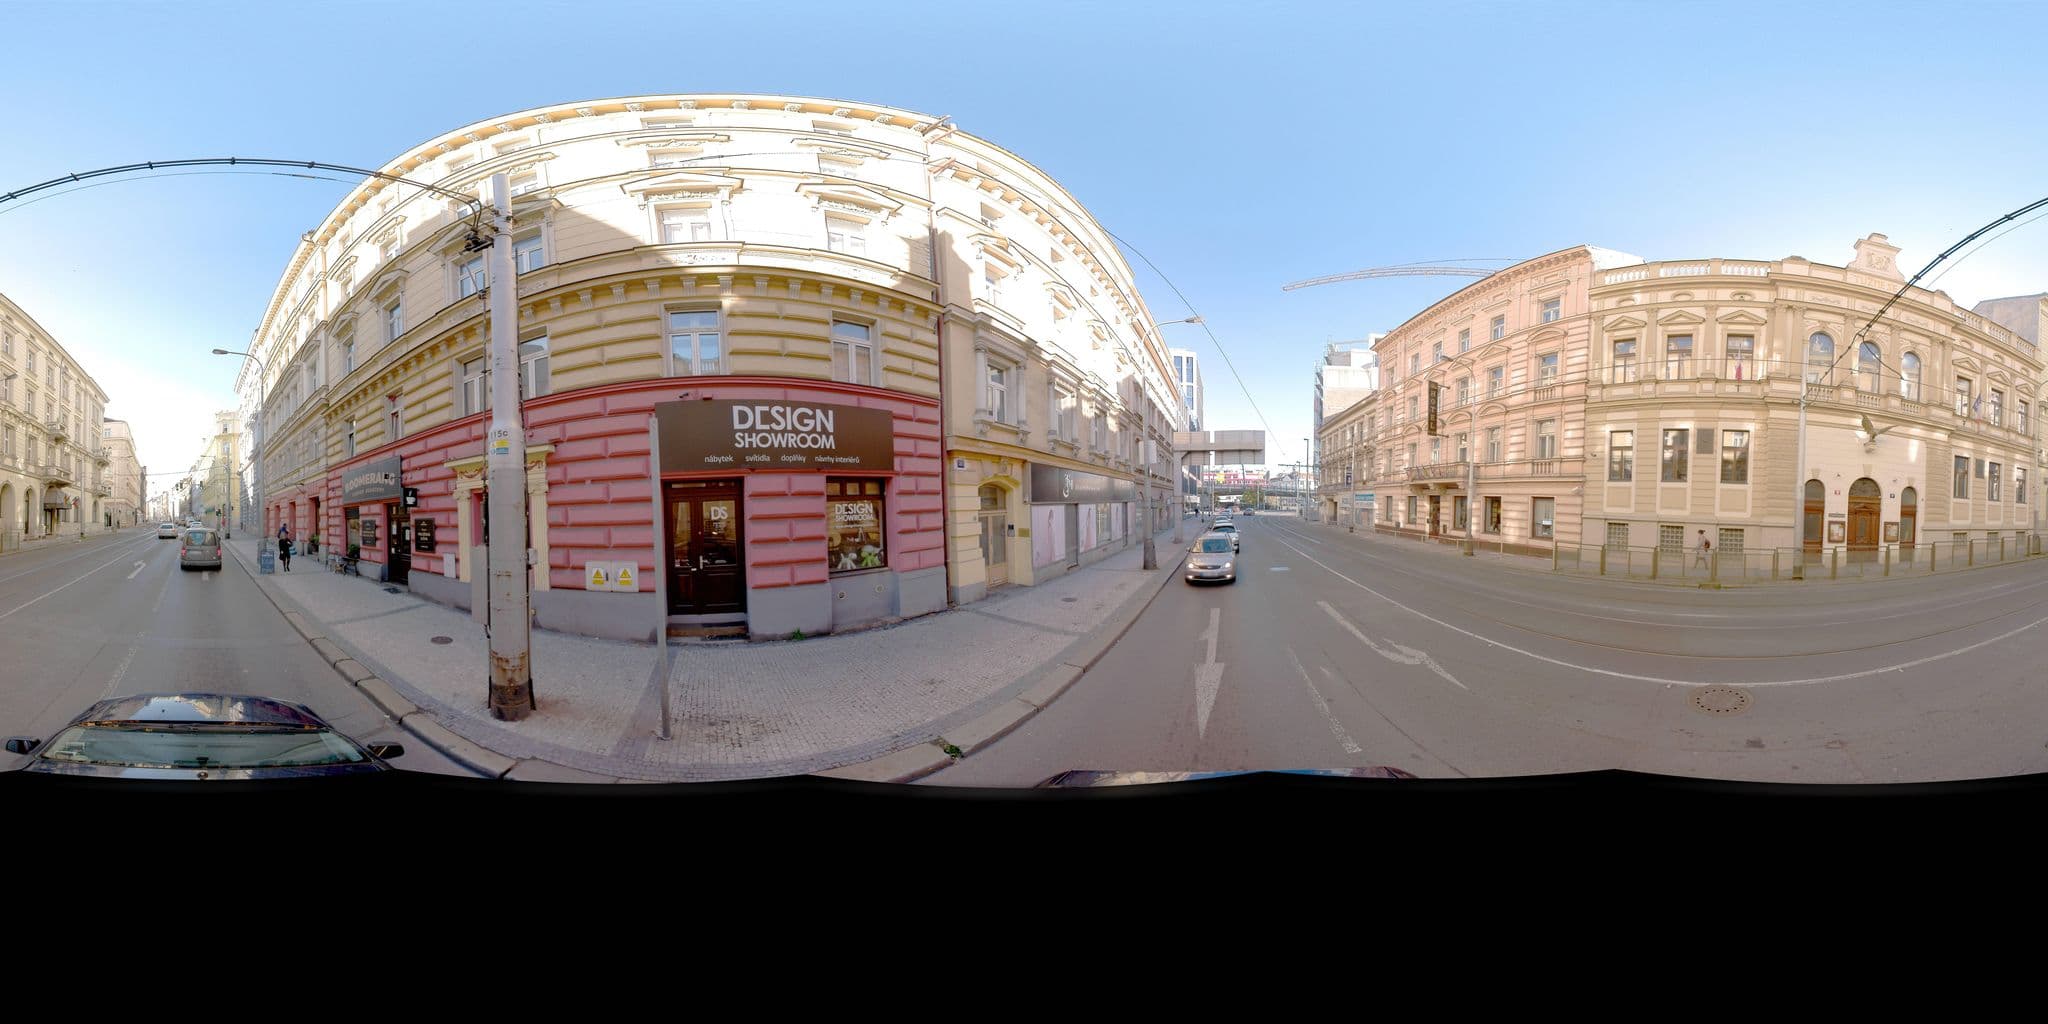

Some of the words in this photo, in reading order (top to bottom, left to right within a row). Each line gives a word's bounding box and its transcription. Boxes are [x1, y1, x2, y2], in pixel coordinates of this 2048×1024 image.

[732, 405, 834, 432] DESIGN
[734, 432, 836, 449] SHOWROOM
[704, 454, 734, 463] nábytek
[745, 454, 770, 462] svítidla
[781, 454, 807, 463] doplňky
[711, 506, 728, 520] DS
[835, 502, 873, 514] DESIGN
[834, 513, 873, 521] SHOWROOM
